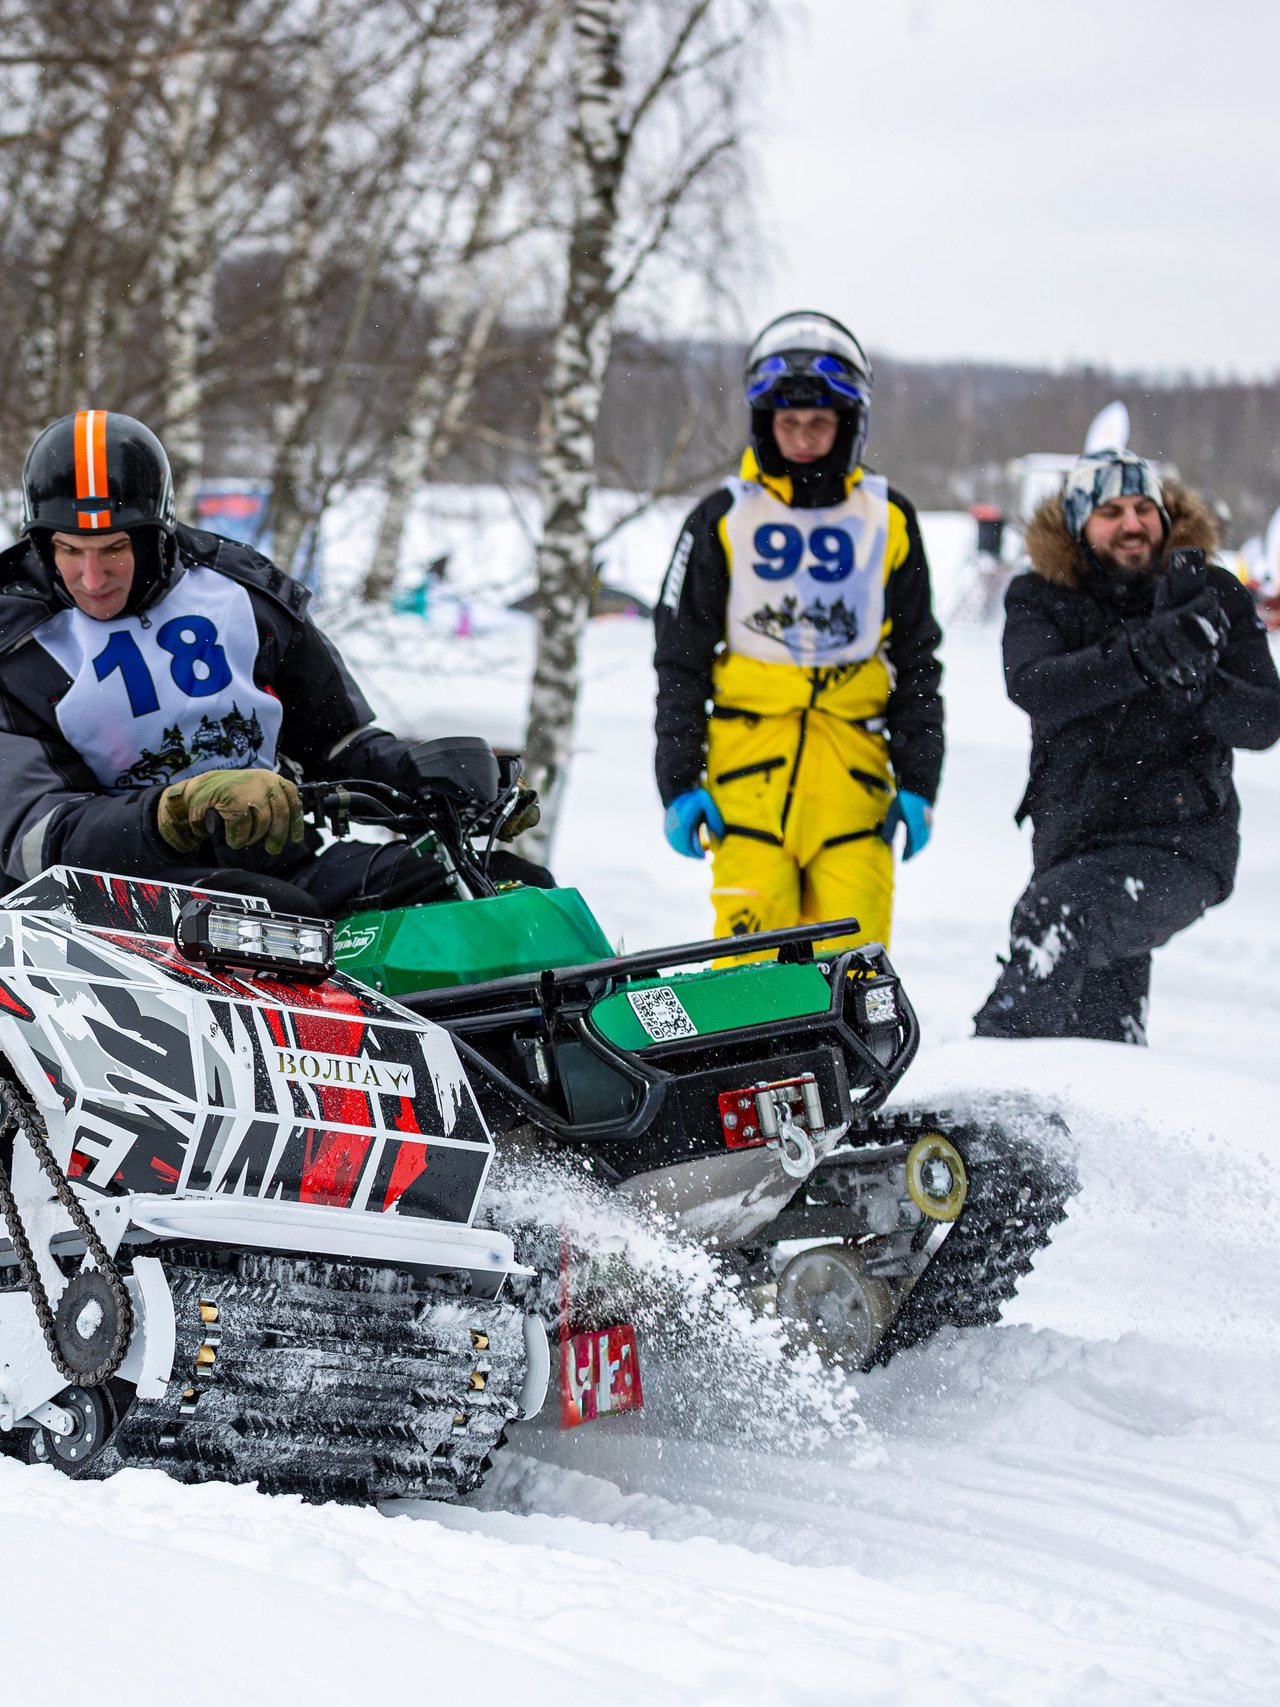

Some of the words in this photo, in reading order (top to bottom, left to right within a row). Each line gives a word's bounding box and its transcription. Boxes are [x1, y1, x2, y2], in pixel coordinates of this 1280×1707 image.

[751, 522, 855, 584] 99
[92, 615, 233, 719] 18
[276, 1051, 383, 1087] ВОЛГА
